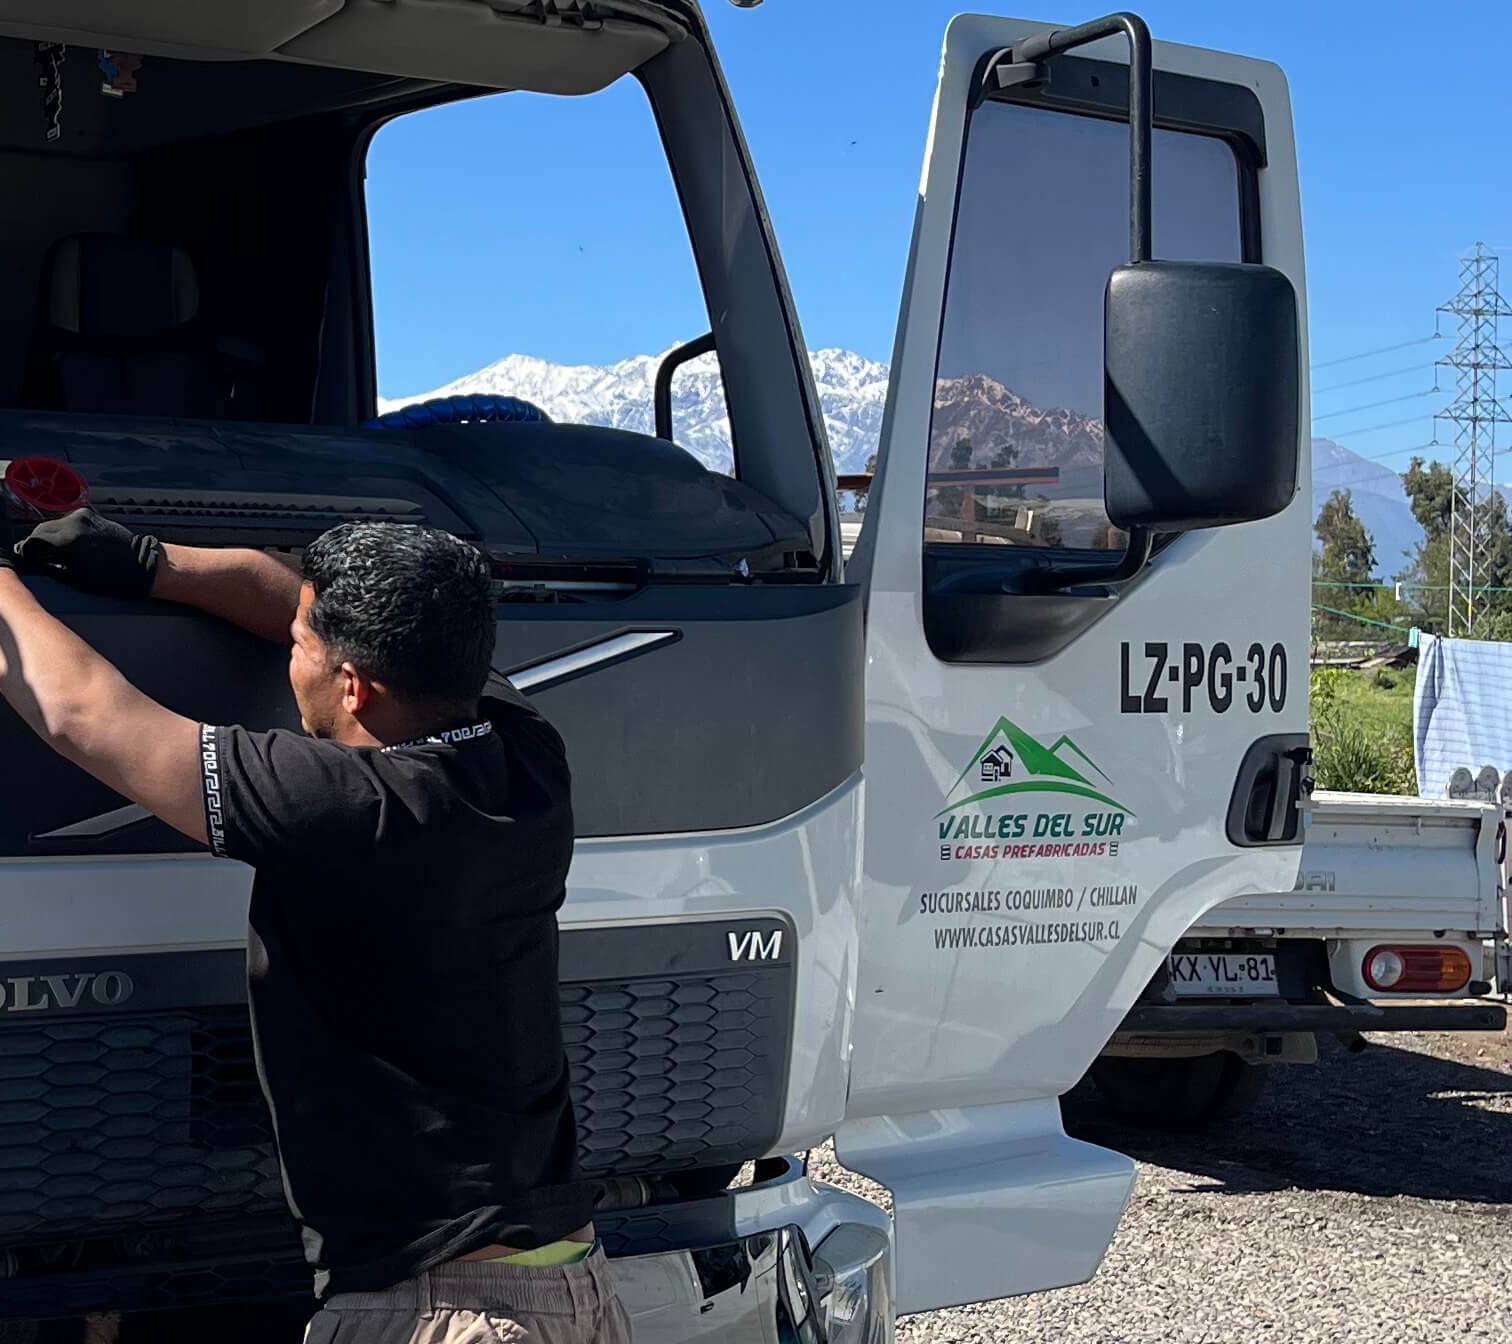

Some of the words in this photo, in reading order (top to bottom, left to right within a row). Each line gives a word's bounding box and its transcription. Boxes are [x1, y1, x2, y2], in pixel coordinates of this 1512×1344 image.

[1120, 641, 1288, 714] LZ-PG-30
[938, 814, 1028, 840] VALLES
[1032, 813, 1076, 838] DEL
[1080, 812, 1125, 836] SUR
[954, 844, 1000, 860] CASAS
[1002, 842, 1107, 859] PREFABRICADAS
[919, 890, 1001, 915] SUCURSALES
[1005, 887, 1074, 912] COQUIMBO
[1076, 887, 1088, 912] /
[1090, 884, 1138, 908] CHILLAN
[728, 930, 782, 961] VM
[934, 920, 1120, 950] WWW.CASASVALLESDELSUR.CL
